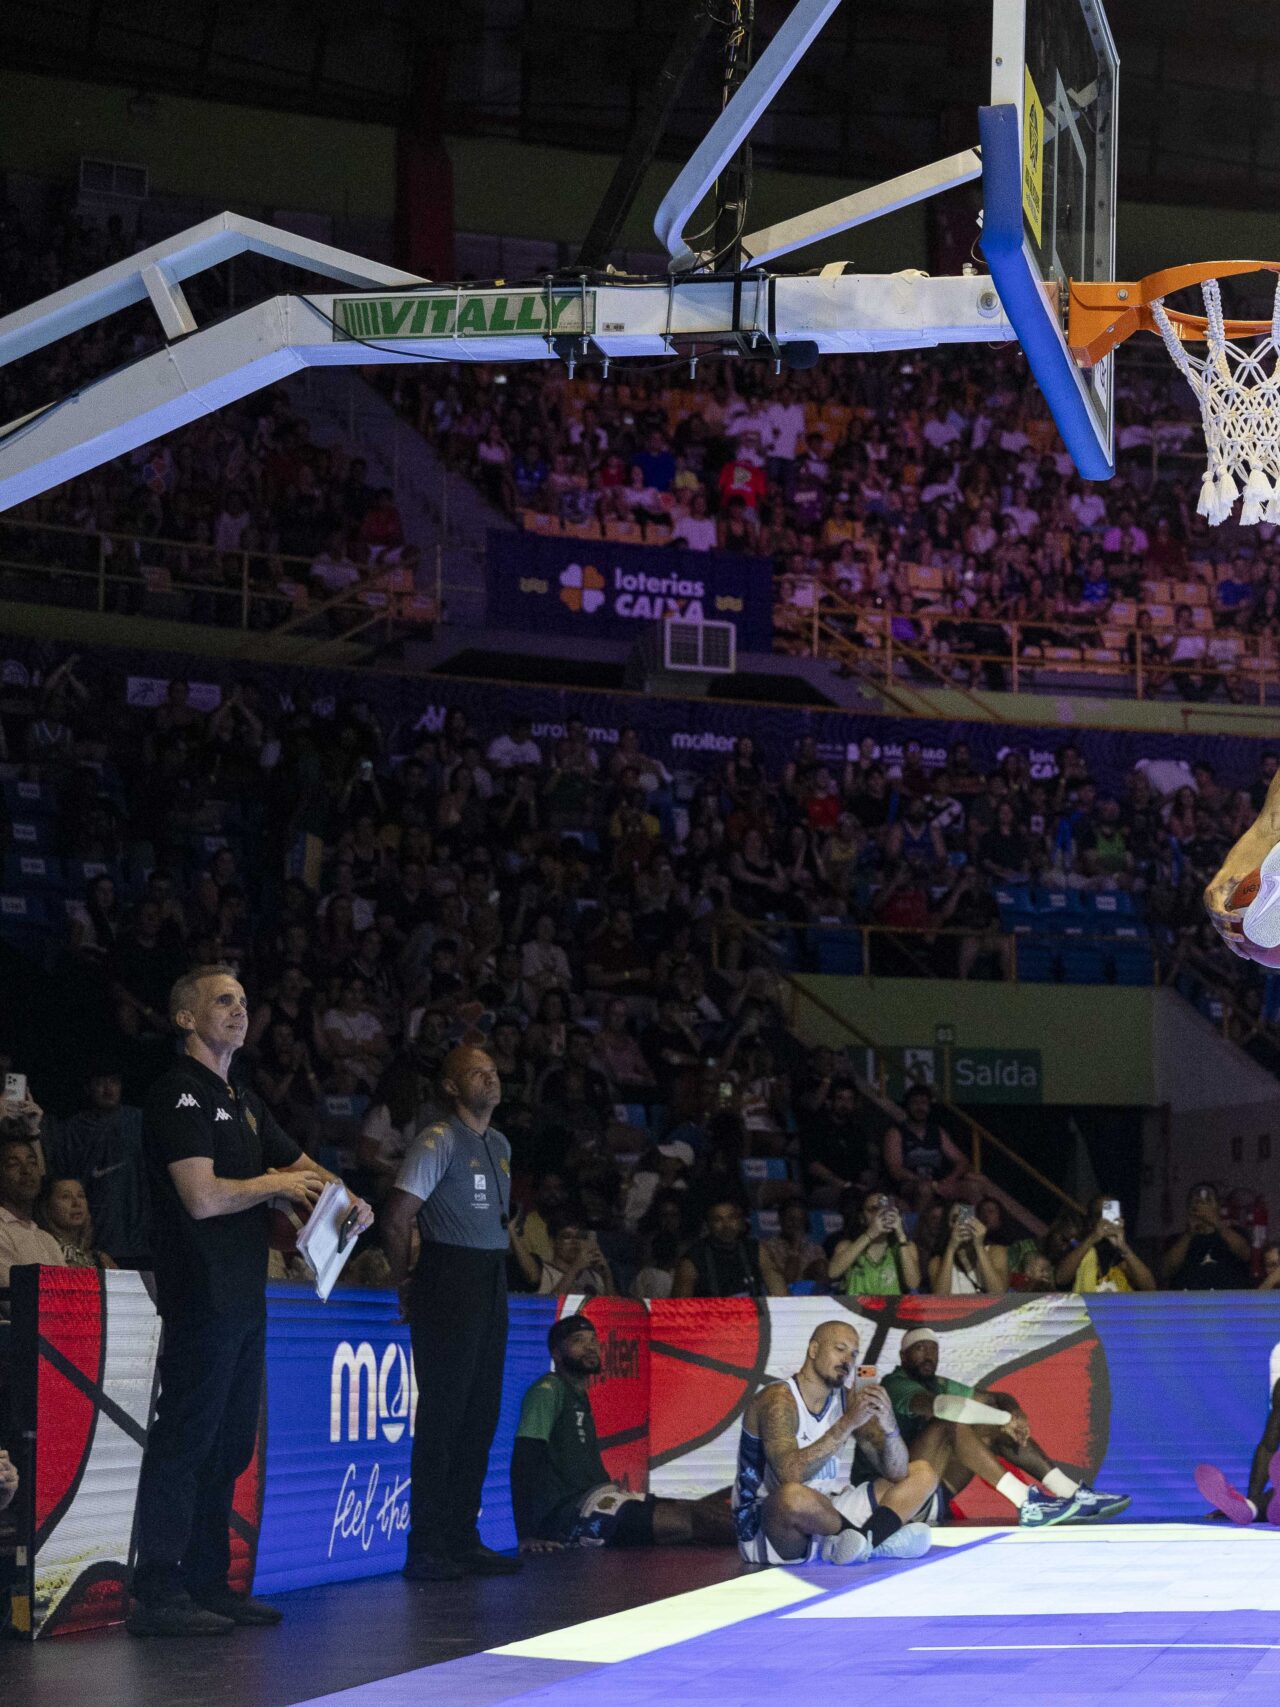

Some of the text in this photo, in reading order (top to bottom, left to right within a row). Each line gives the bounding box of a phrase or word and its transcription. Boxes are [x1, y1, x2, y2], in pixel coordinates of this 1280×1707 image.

[379, 295, 576, 334] VITALLY
[614, 566, 706, 598] loterias
[614, 593, 704, 624] CAIXA
[955, 1058, 1038, 1088] Saída
[328, 1462, 412, 1558] feel the
